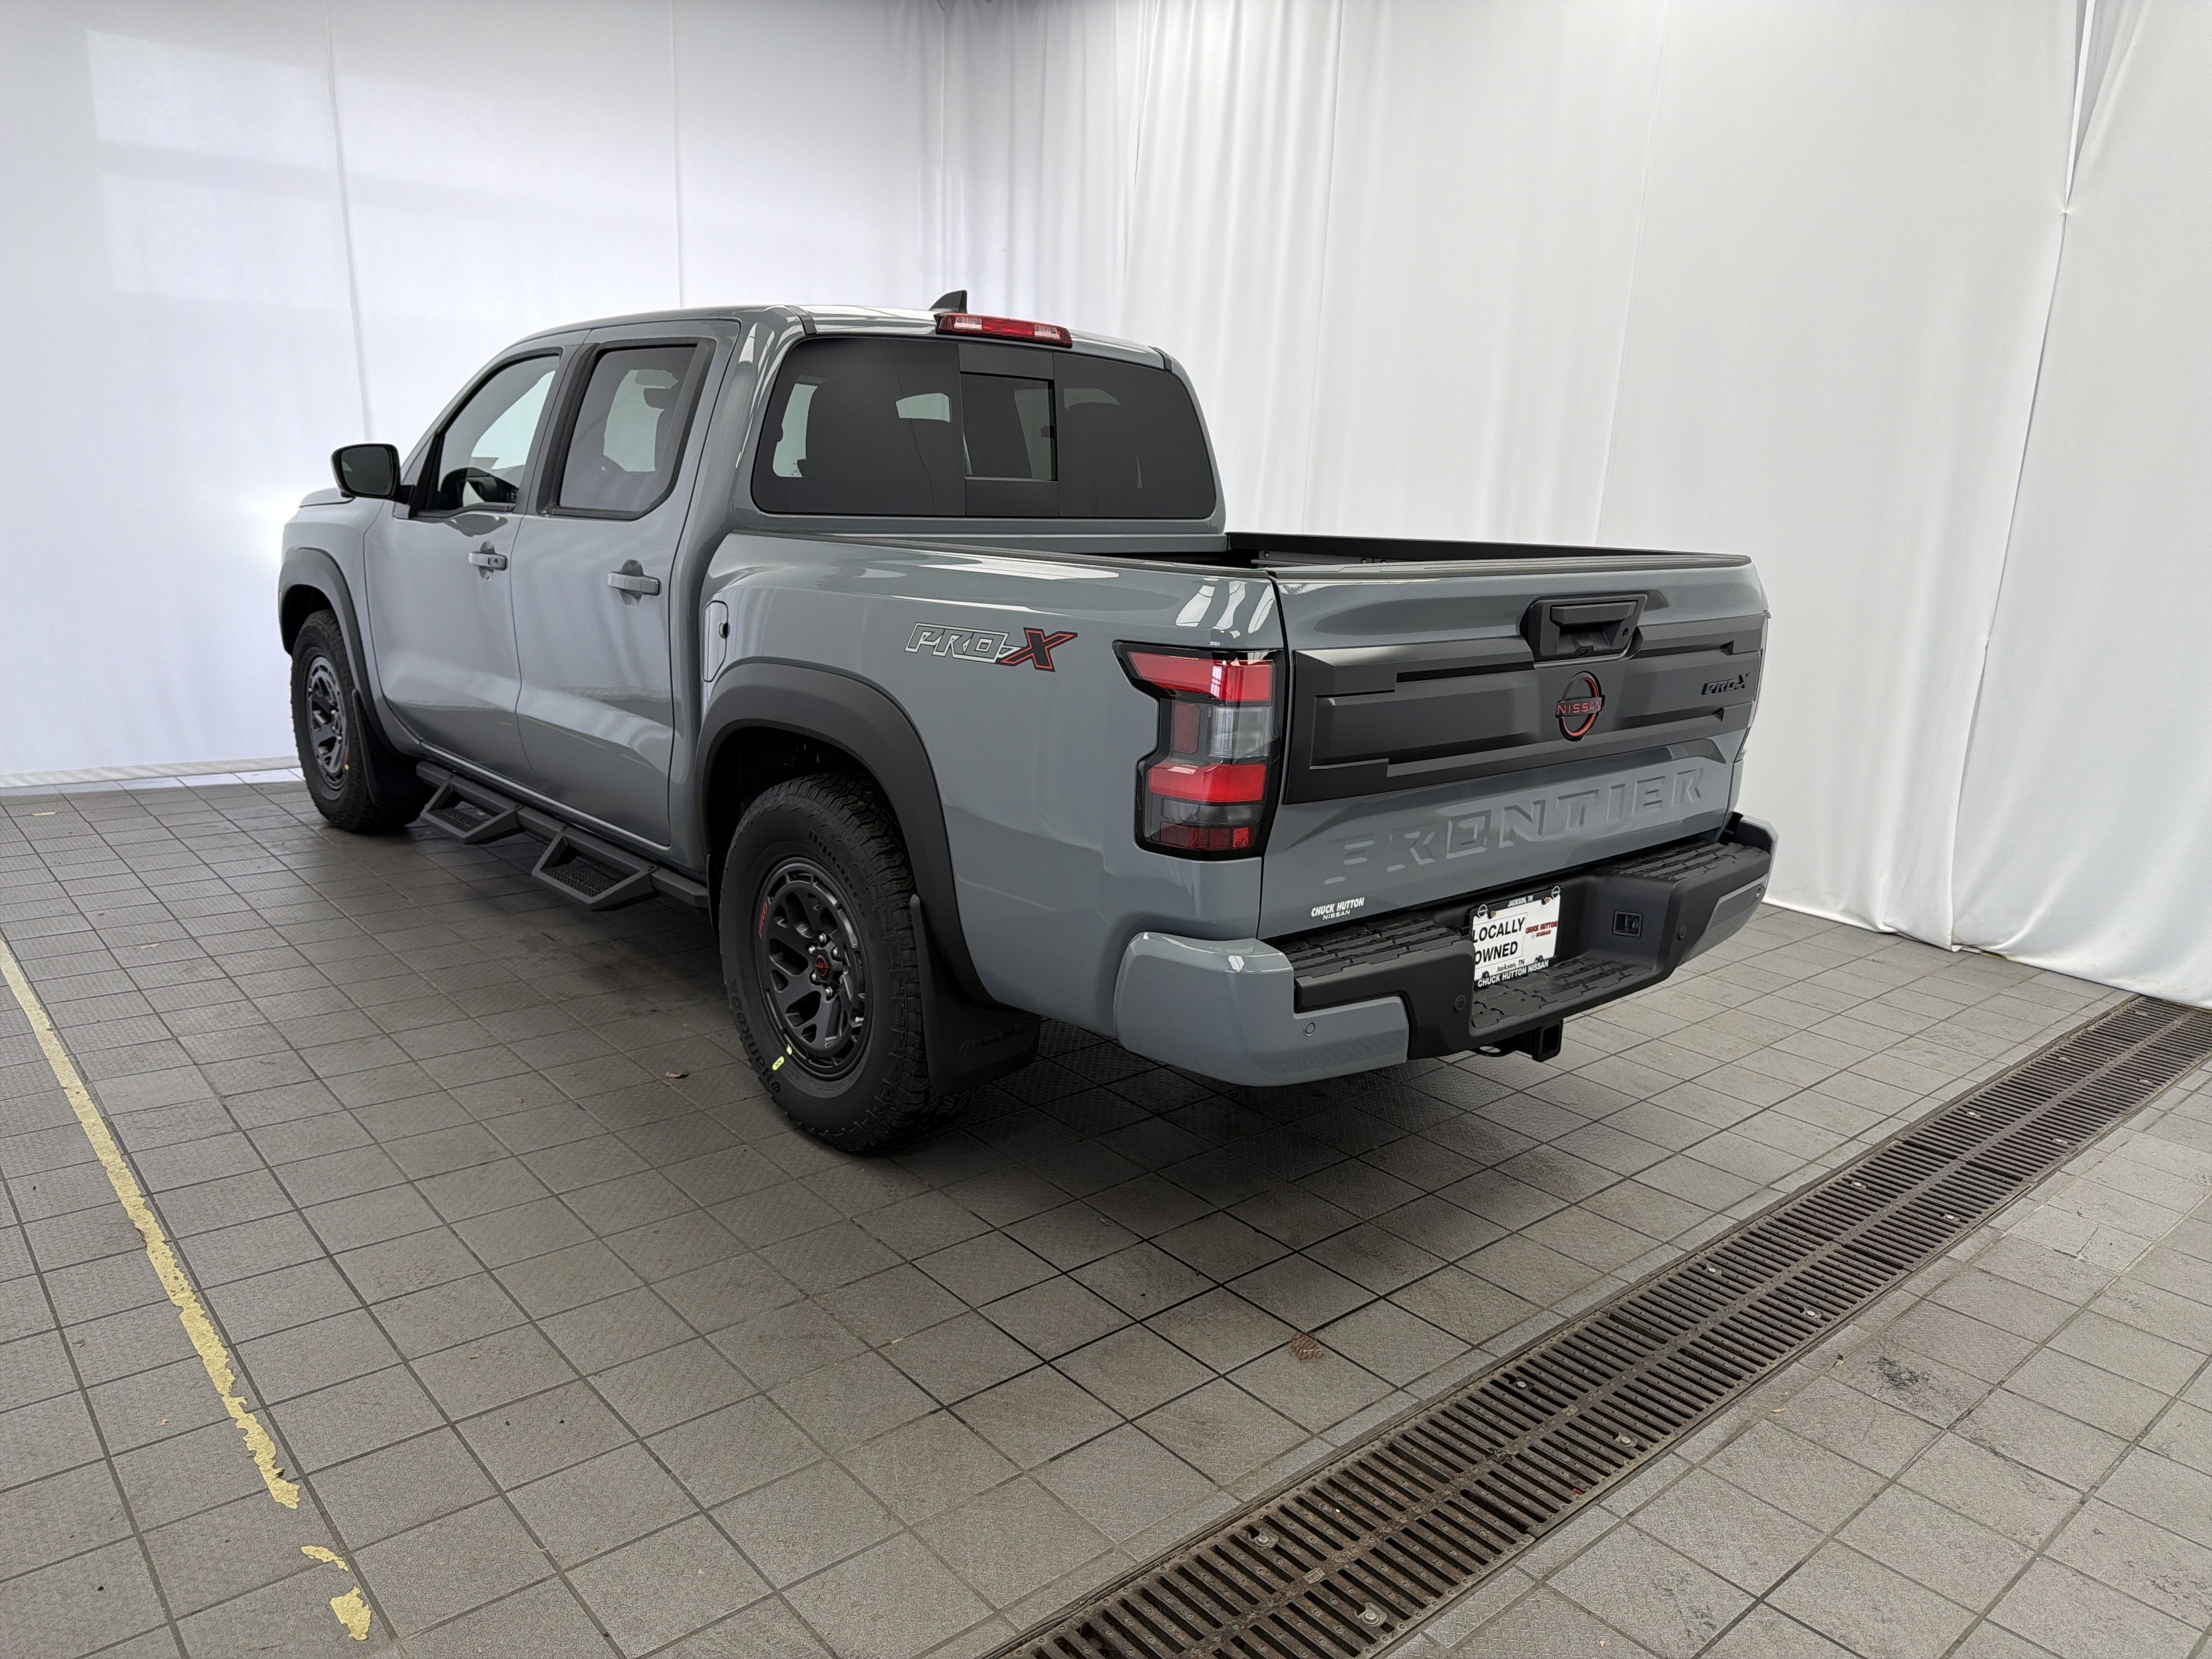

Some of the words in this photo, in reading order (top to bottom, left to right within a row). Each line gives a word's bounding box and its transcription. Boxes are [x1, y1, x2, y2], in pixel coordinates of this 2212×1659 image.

[1557, 701, 1601, 714] NISSAN
[1324, 769, 1704, 884] FRONTIER
[1311, 903, 1335, 917] CHUCK
[1336, 897, 1364, 911] HUTTON
[1323, 910, 1350, 920] NISSAN
[1471, 917, 1525, 943] LOCALLY
[1526, 924, 1539, 934] CHUCK
[1540, 921, 1558, 930] HUTTON
[1475, 941, 1517, 965] OWNED
[1478, 974, 1500, 987] CHUCK
[1502, 966, 1526, 980] HUTTON
[1528, 960, 1549, 973] NISSAN
[1497, 963, 1517, 973] Jackson,
